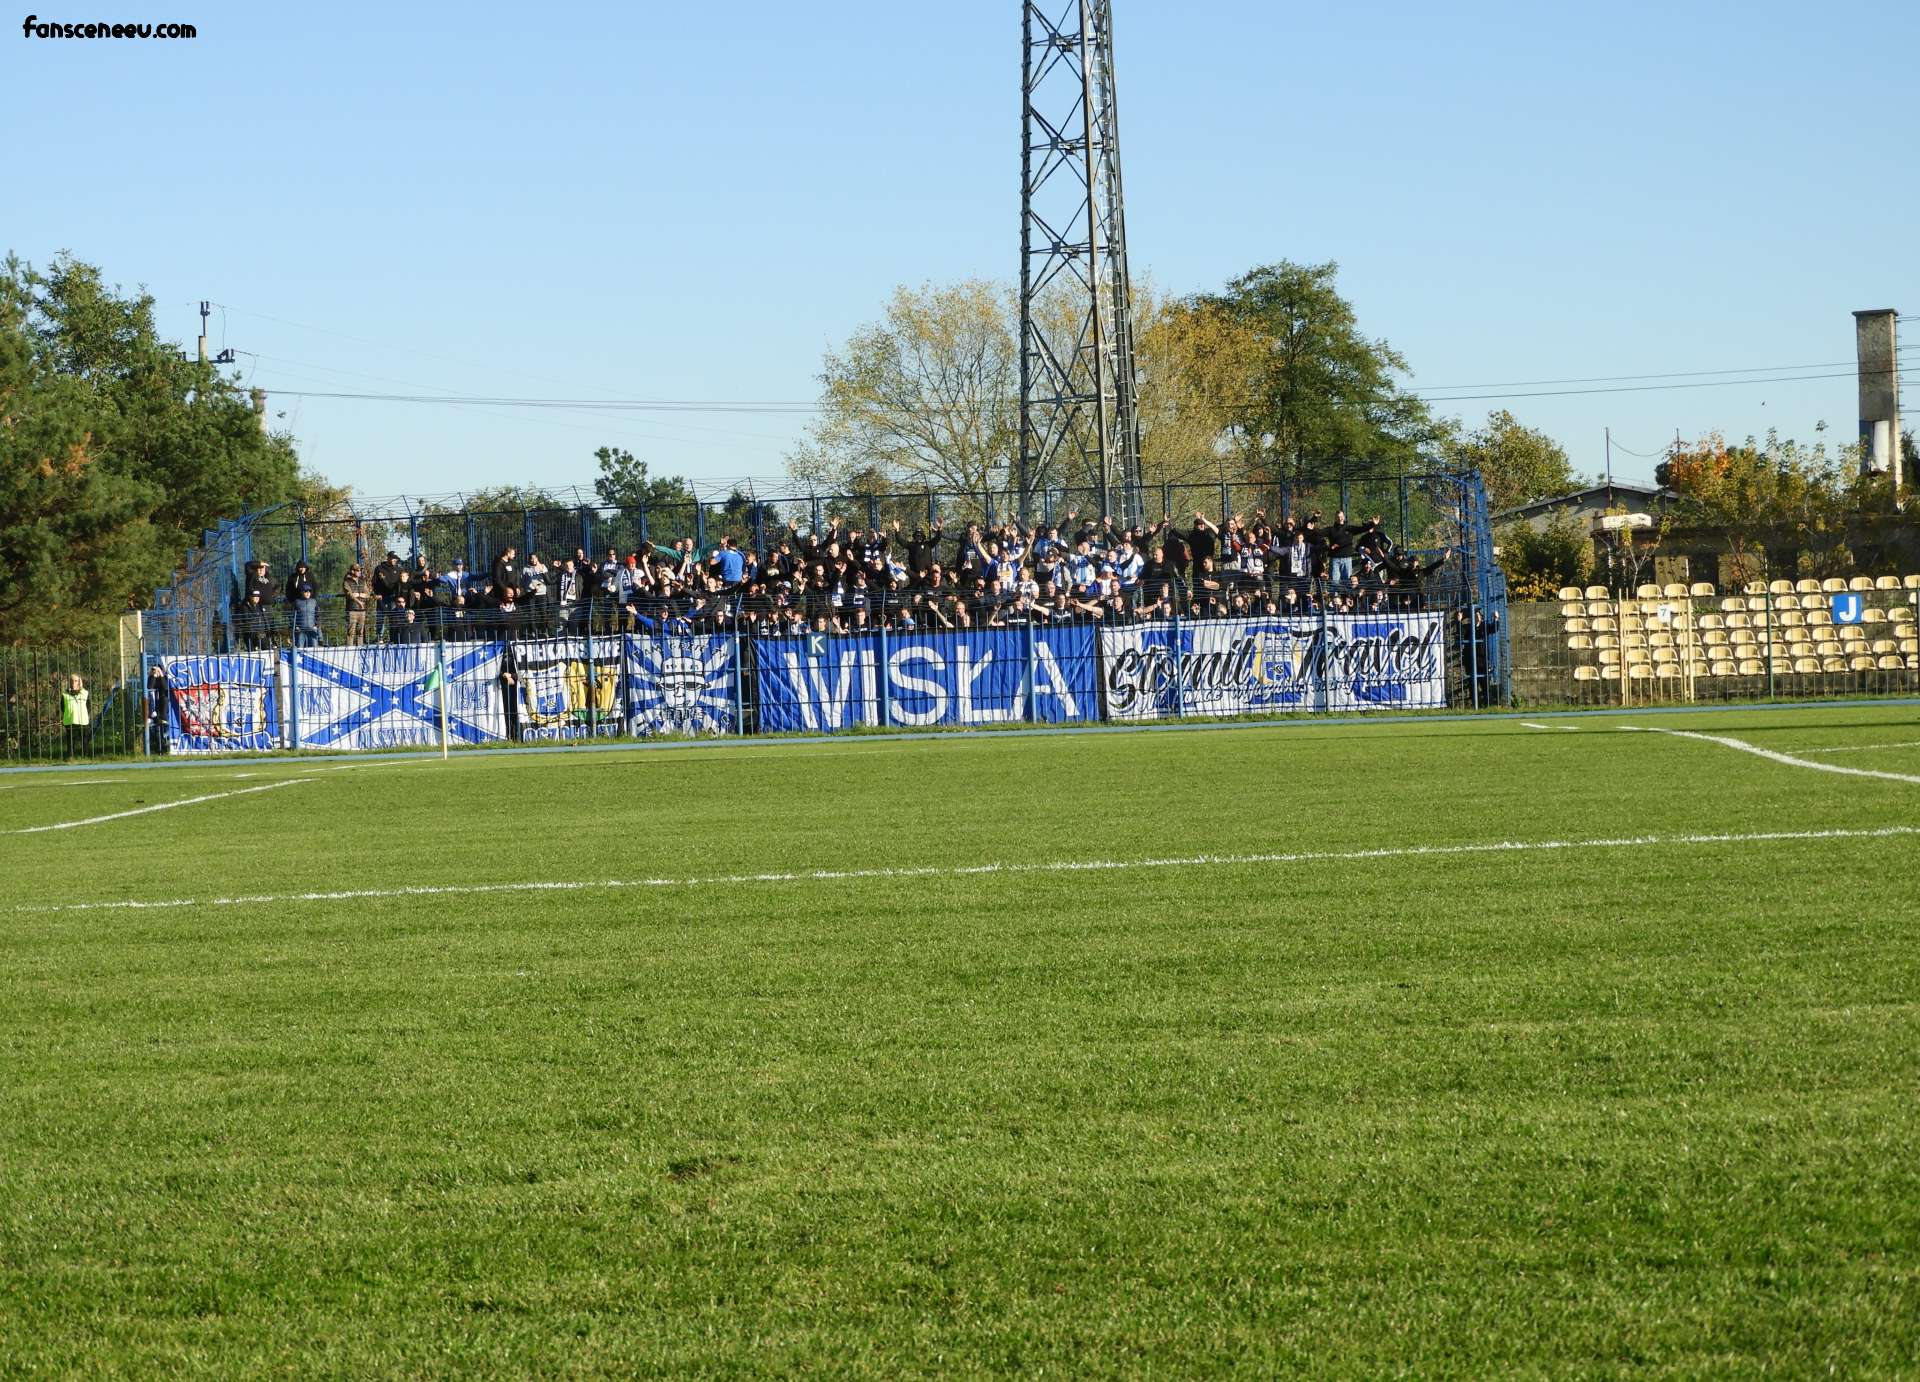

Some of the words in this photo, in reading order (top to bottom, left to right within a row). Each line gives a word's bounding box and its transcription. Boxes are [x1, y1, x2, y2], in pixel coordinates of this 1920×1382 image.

[1839, 595, 1857, 622] J
[811, 635, 825, 654] K
[168, 656, 264, 690] STOMIL
[360, 646, 425, 673] STOMIL
[1109, 637, 1253, 710] Stomil
[1291, 622, 1438, 679] Travel
[300, 687, 332, 714] OKS
